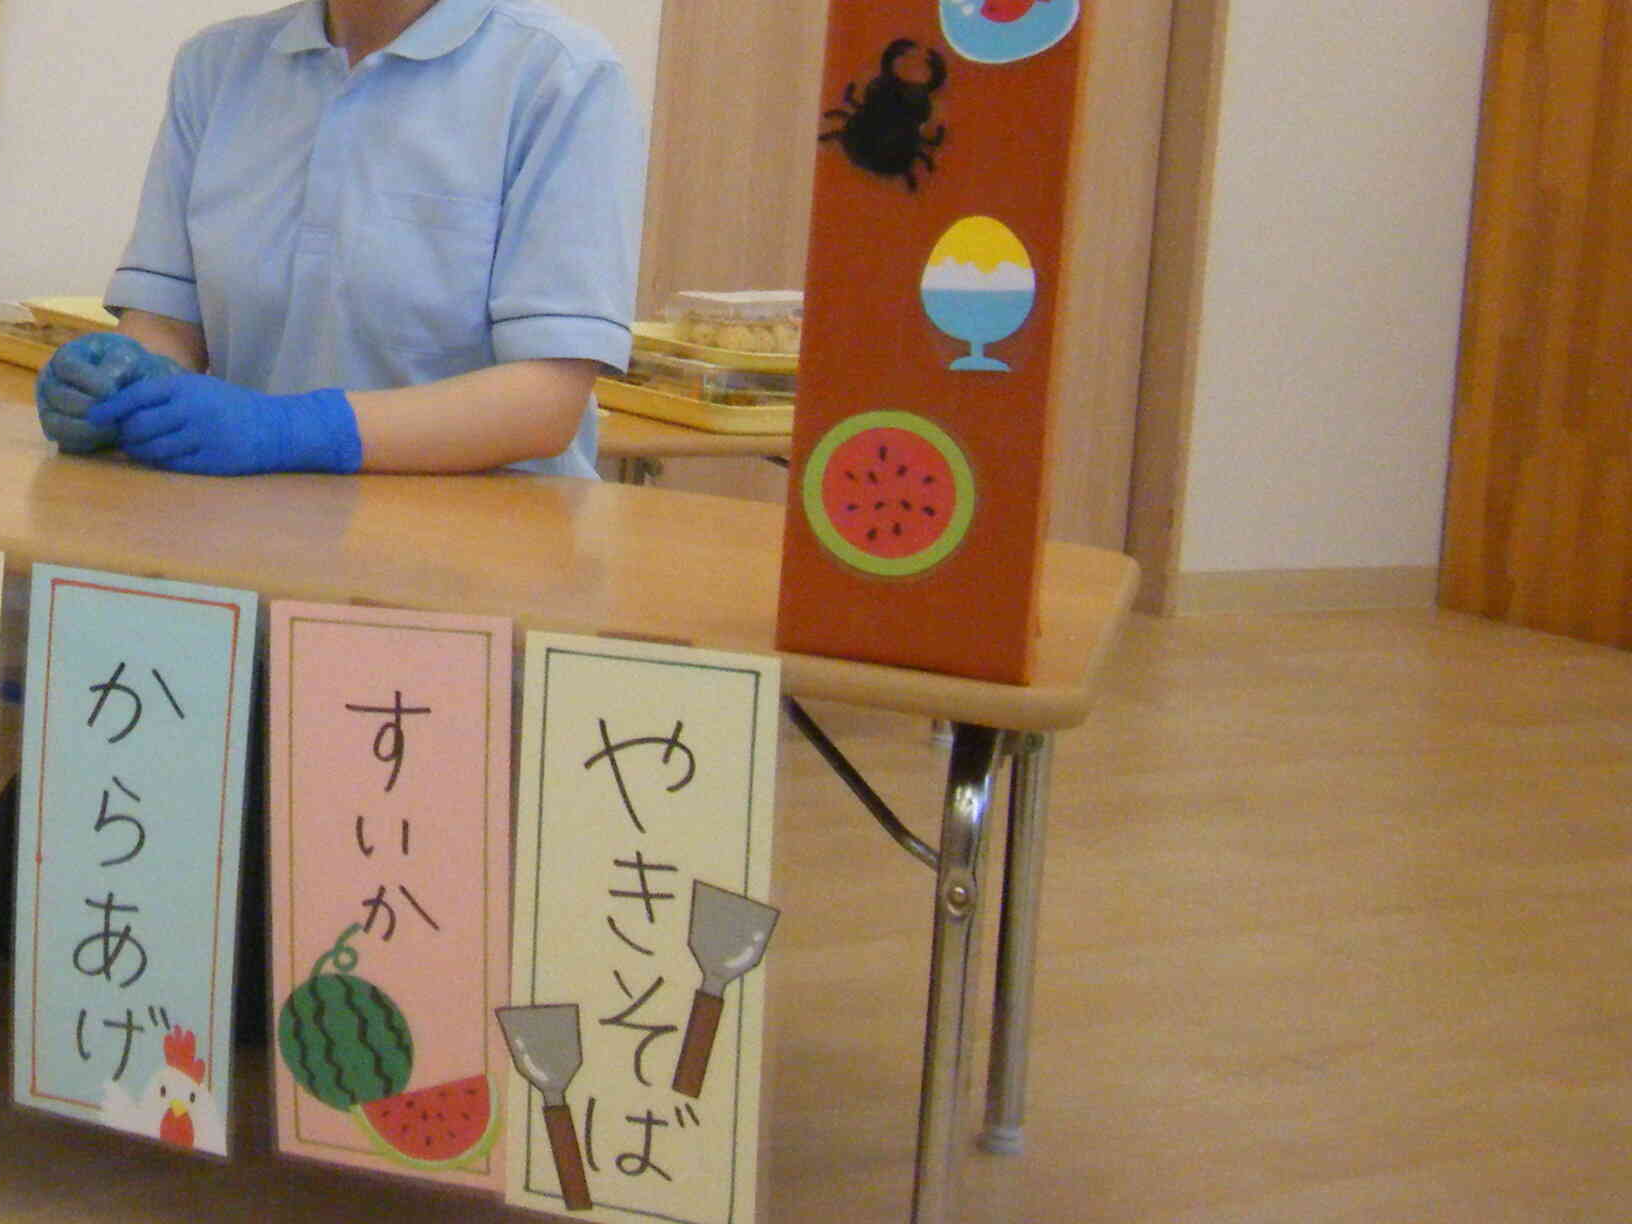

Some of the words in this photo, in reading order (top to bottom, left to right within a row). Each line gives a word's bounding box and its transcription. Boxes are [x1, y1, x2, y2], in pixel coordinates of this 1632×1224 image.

[72, 660, 185, 1083] からあげ
[344, 689, 441, 943] すいか
[583, 718, 702, 1182] やきそば
